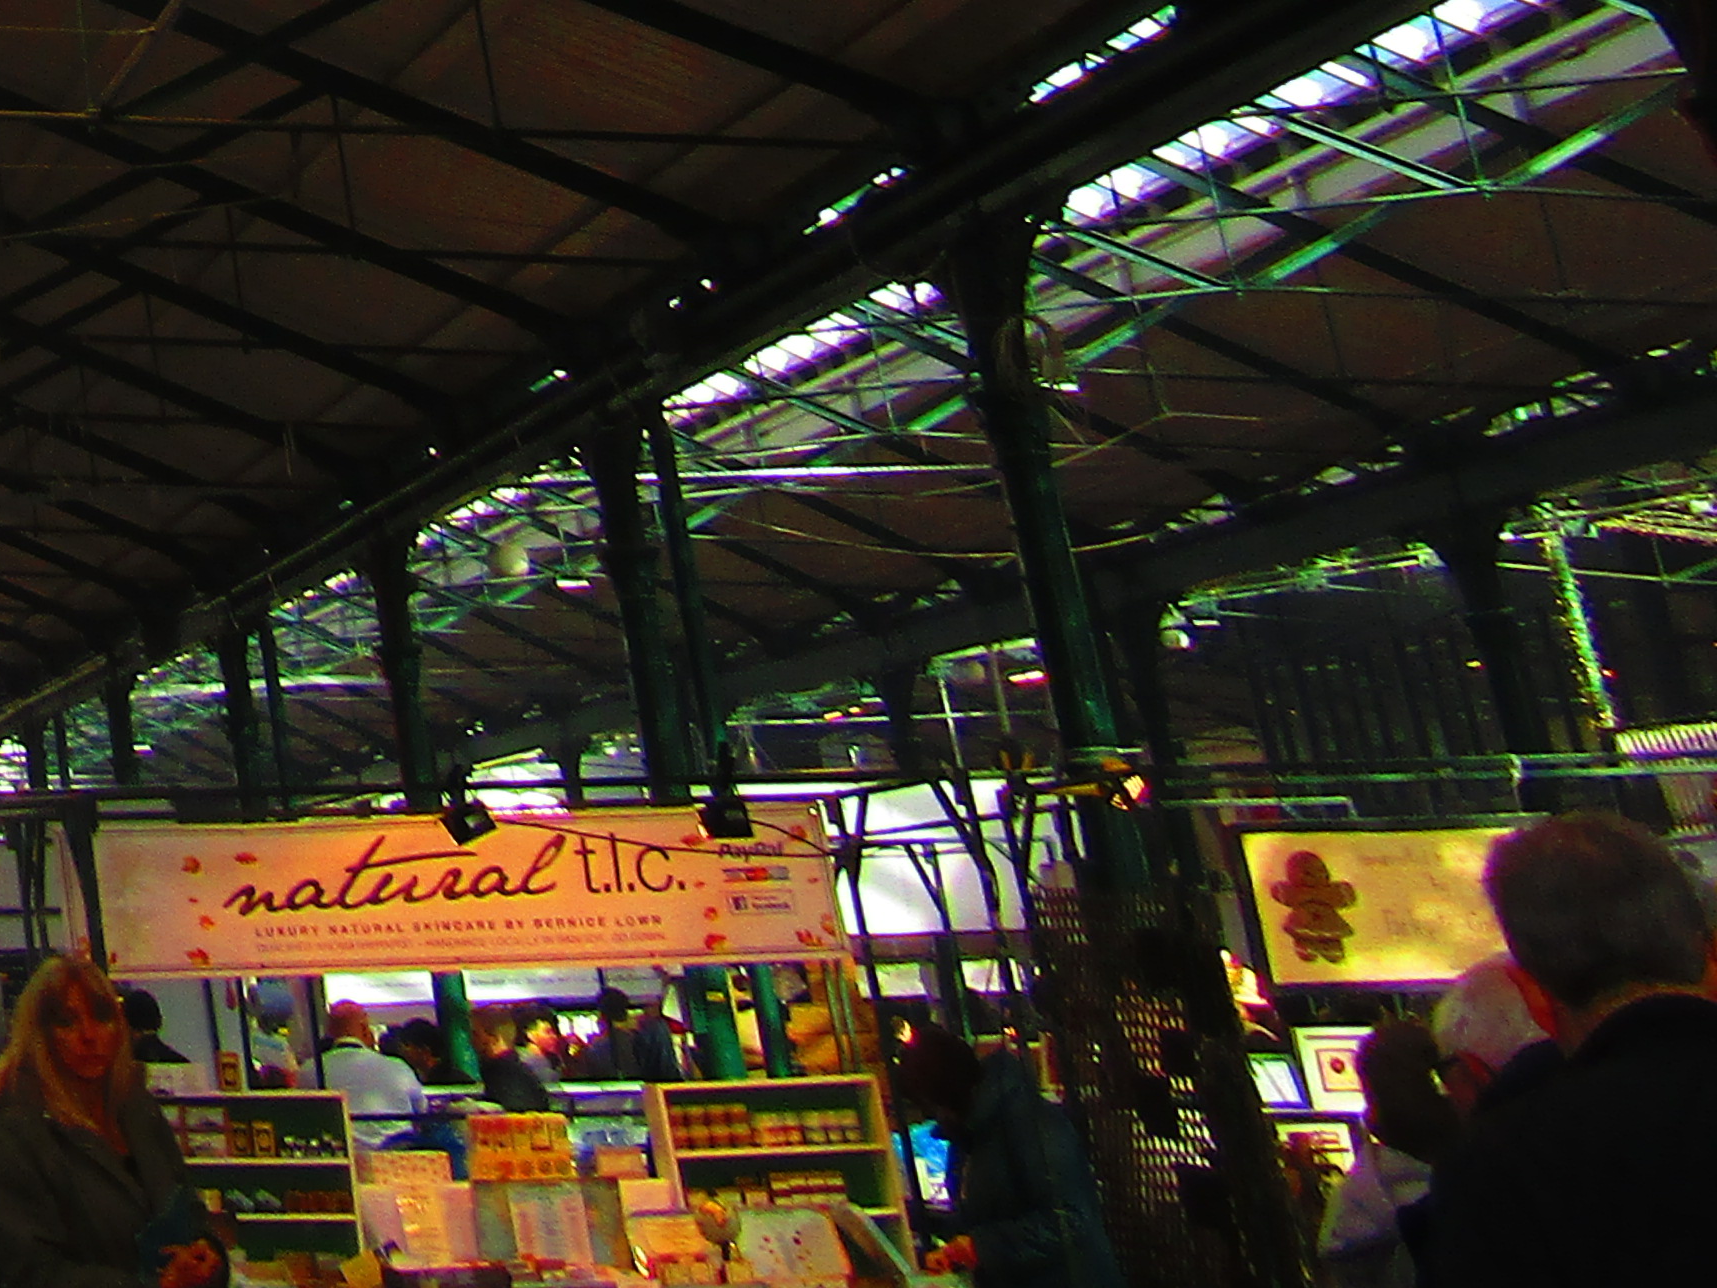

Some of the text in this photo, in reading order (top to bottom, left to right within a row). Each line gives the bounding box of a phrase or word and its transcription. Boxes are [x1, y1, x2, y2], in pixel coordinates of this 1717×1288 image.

[223, 832, 566, 917] natural
[254, 924, 320, 938] LUXURY
[328, 921, 405, 935] NATURAL
[412, 918, 496, 934] SKINCARE
[532, 915, 607, 930] BERNICE
